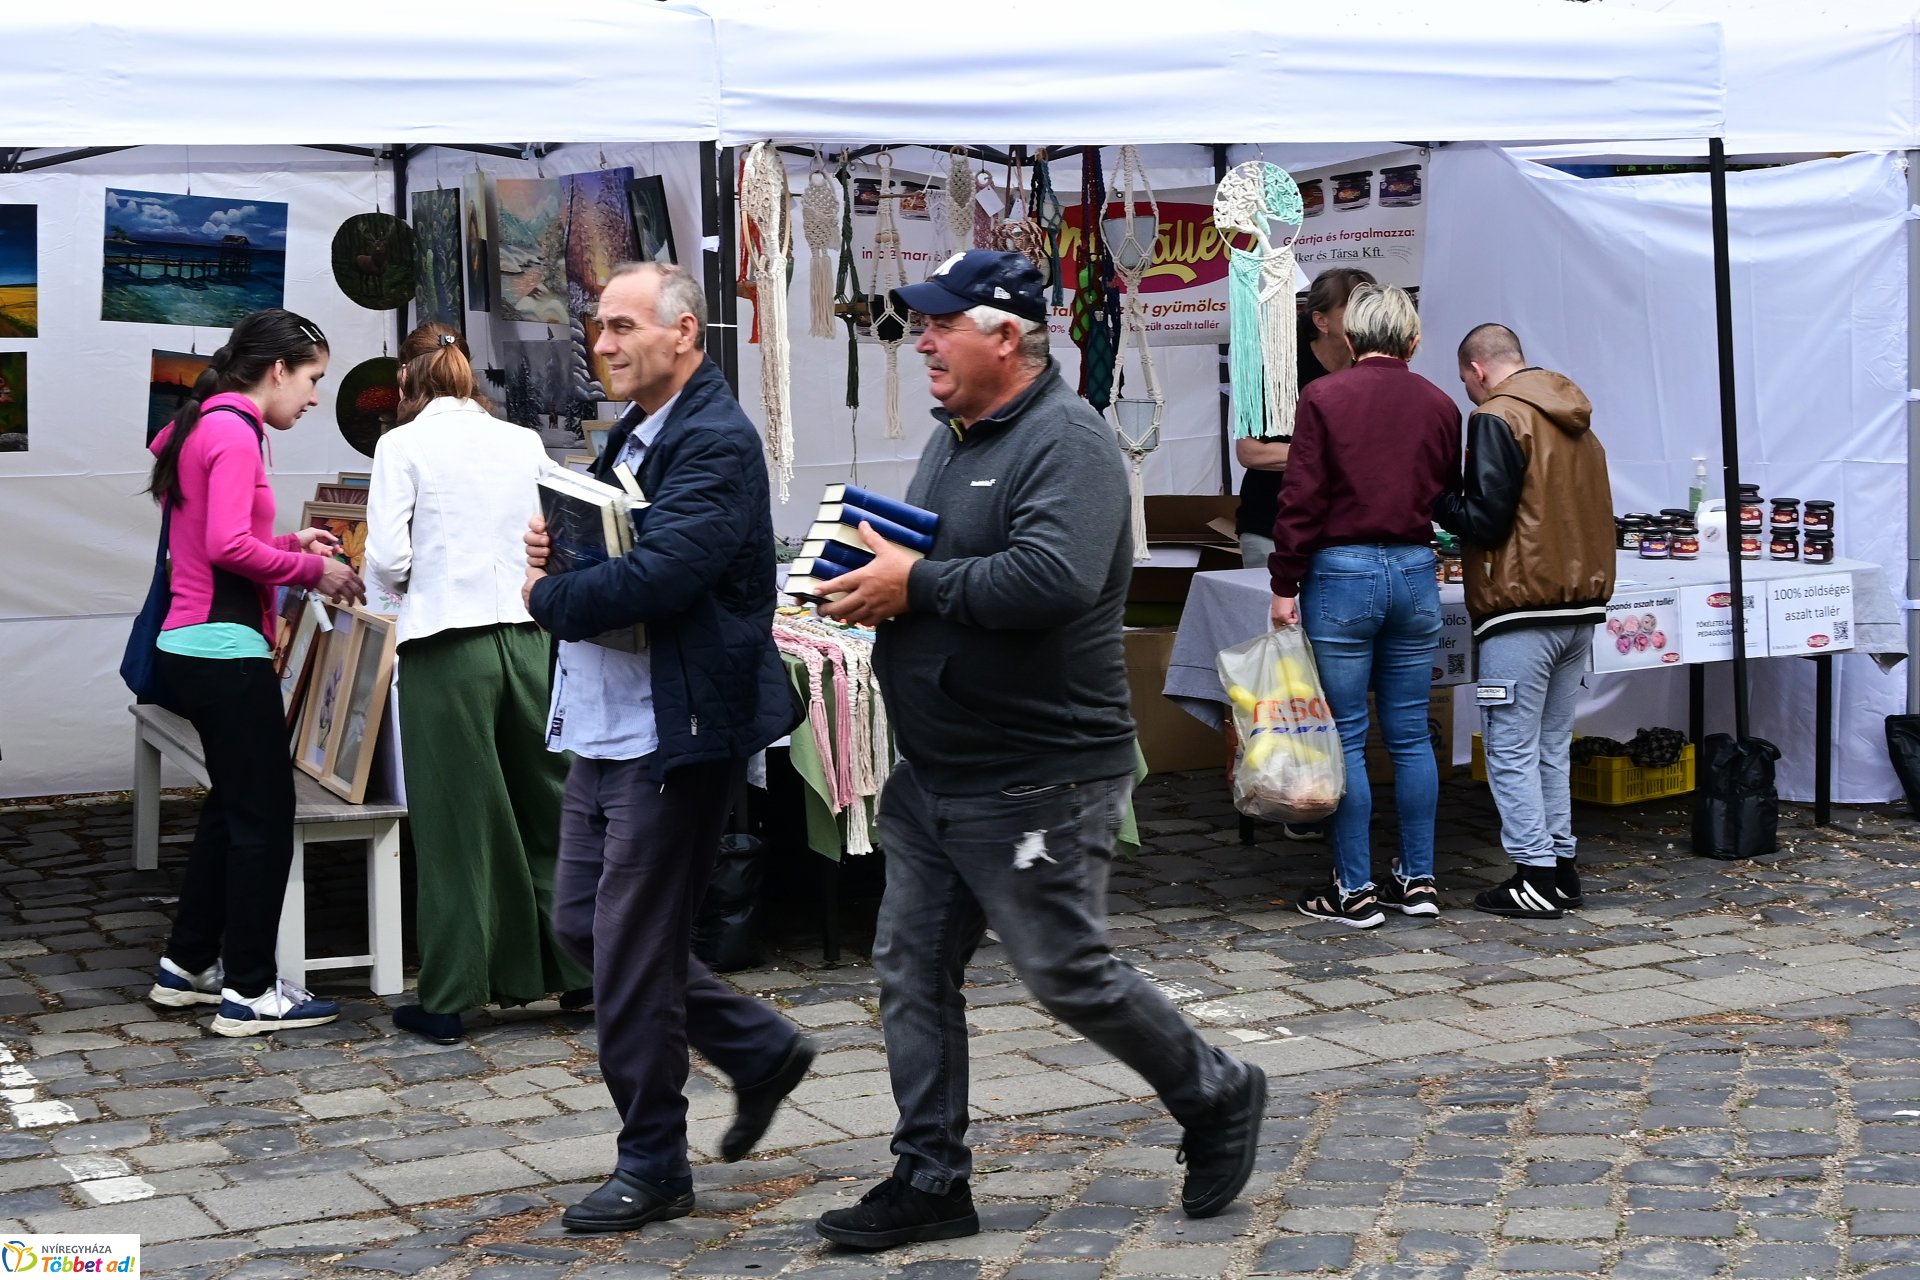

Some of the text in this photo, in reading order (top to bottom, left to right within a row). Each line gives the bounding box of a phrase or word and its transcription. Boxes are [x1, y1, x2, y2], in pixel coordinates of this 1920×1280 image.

[1326, 232, 1337, 242] és
[1340, 227, 1415, 244] forgalmazza:
[1317, 249, 1327, 260] és
[1330, 247, 1359, 259] Társa
[1362, 246, 1384, 258] Kft.
[1152, 298, 1227, 317] gyümölcs
[1129, 321, 1162, 332] kzült
[1164, 320, 1192, 331] aszalt
[1194, 319, 1220, 330] tallér
[1774, 584, 1850, 601] 100% zöldséges
[1634, 599, 1655, 608] aszalt
[1656, 597, 1675, 607] tallér
[1785, 605, 1841, 621] aszalt tallér
